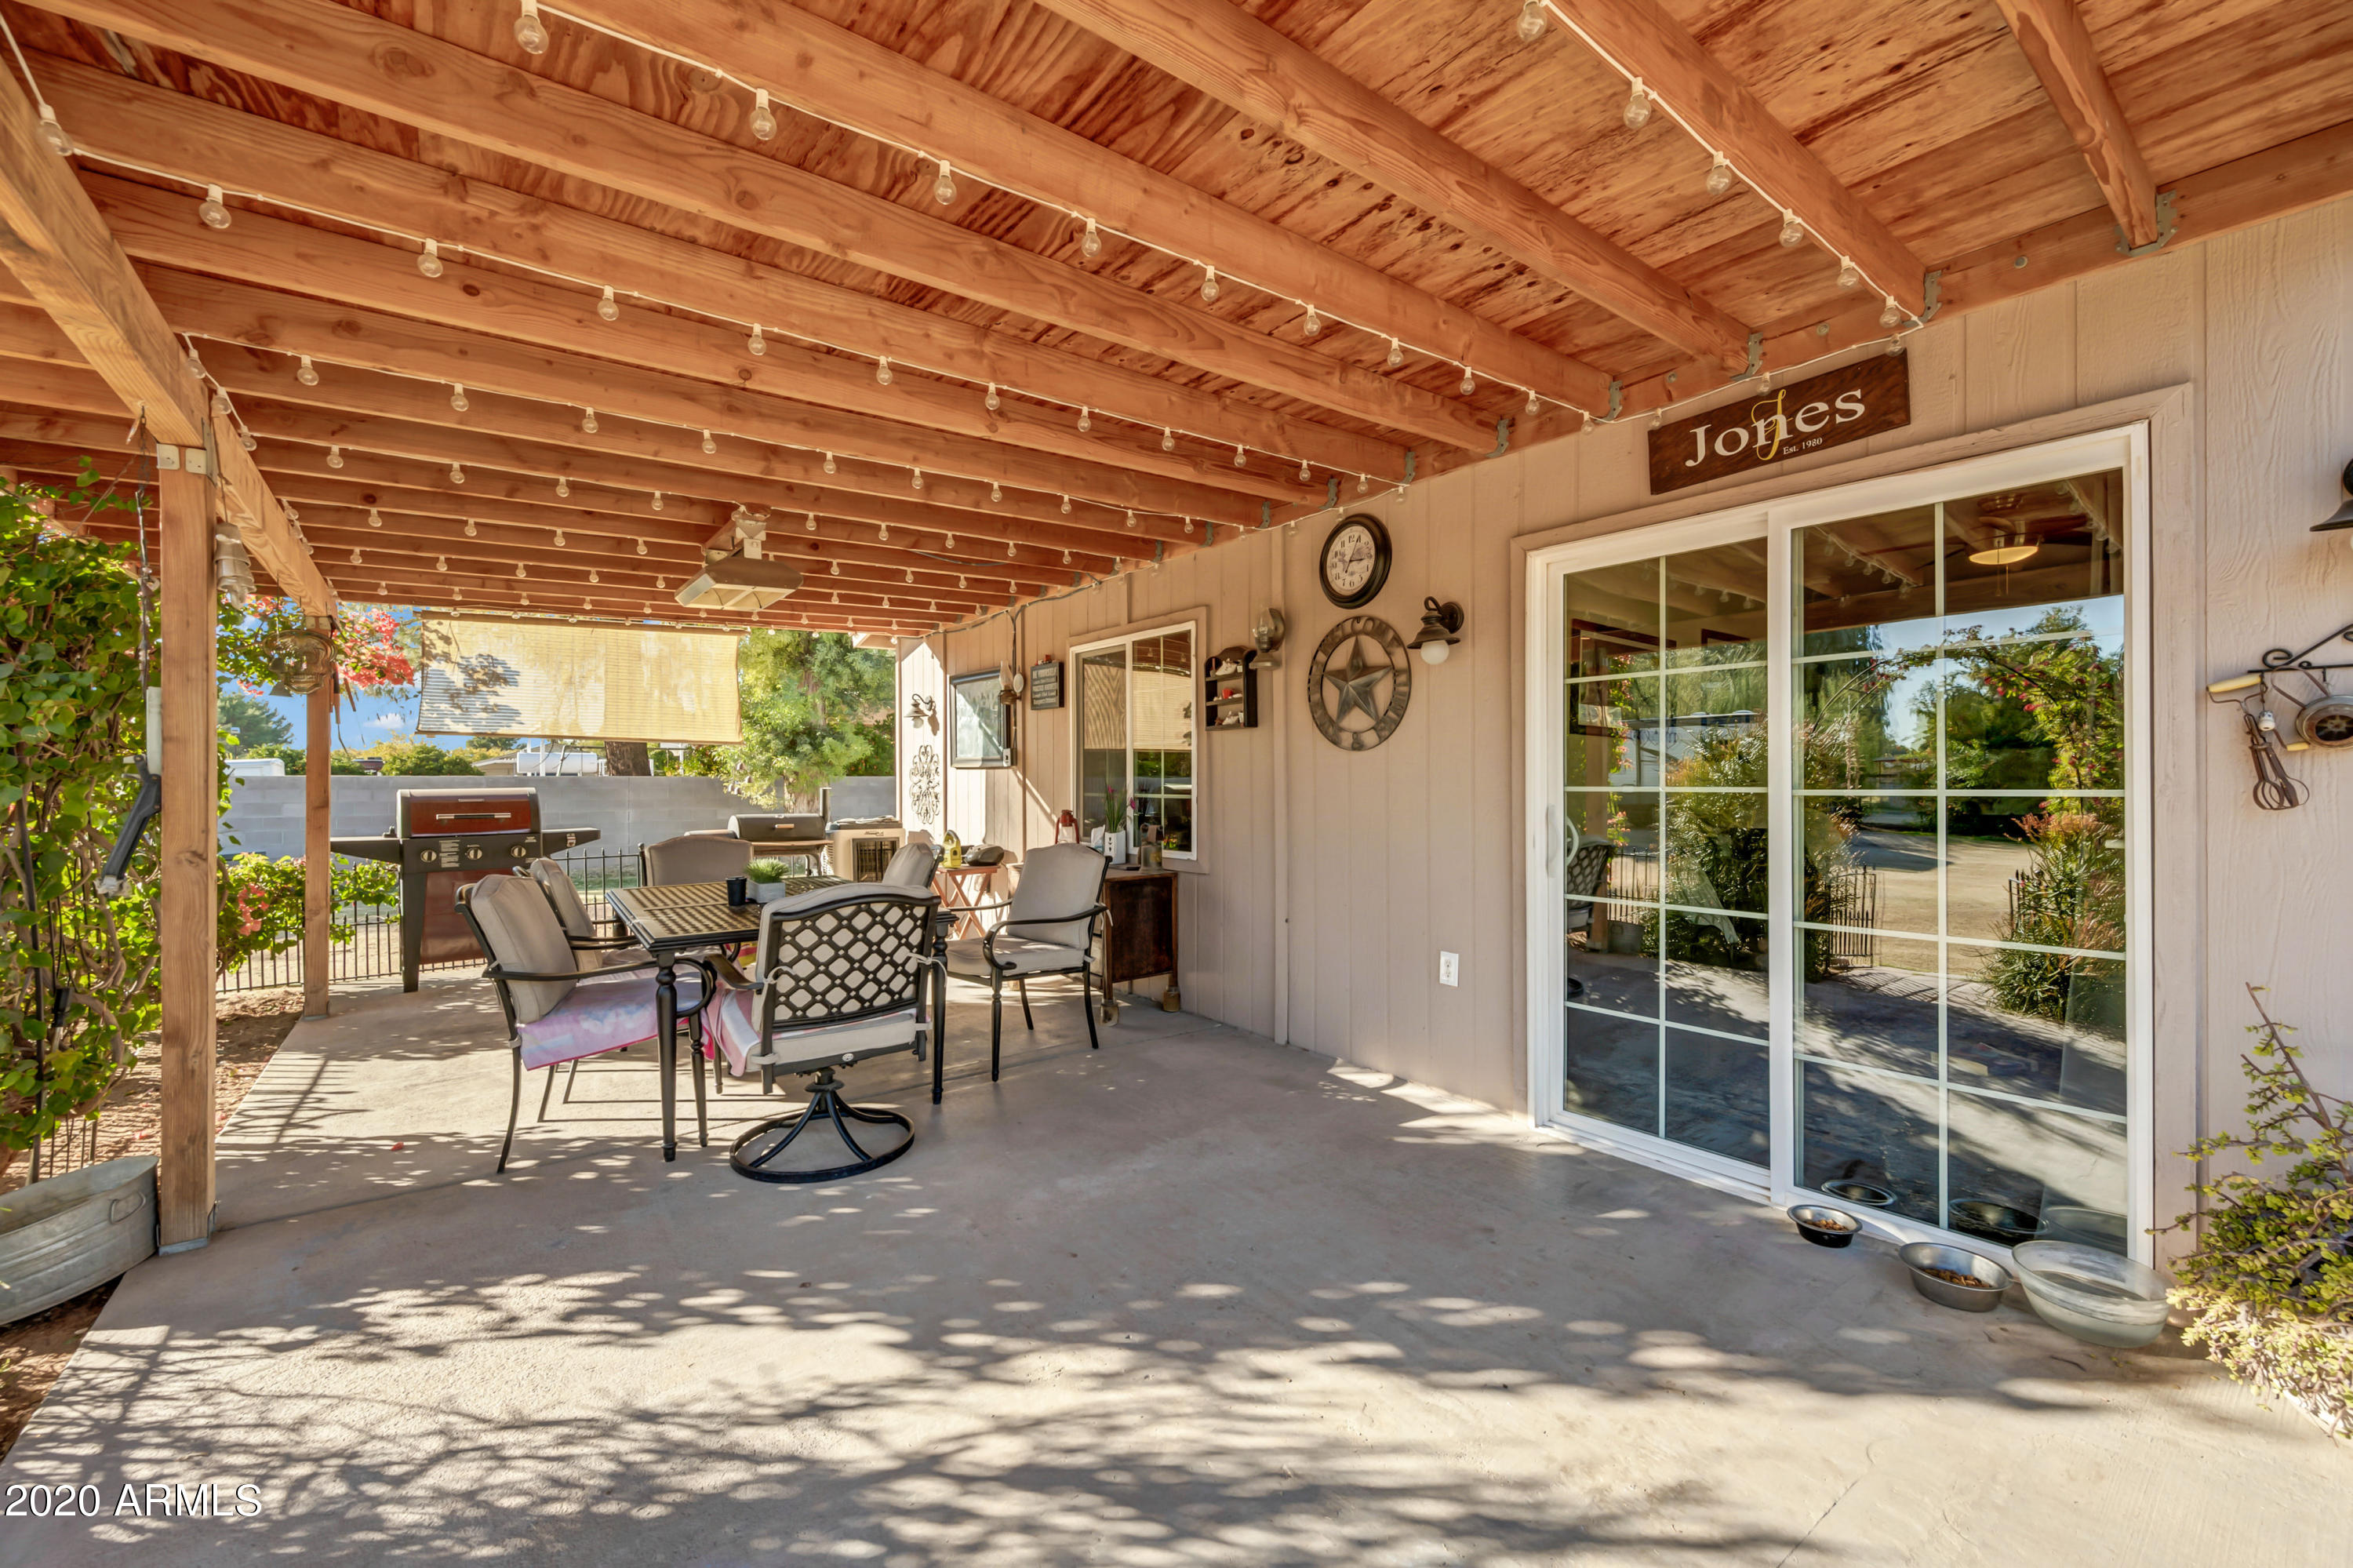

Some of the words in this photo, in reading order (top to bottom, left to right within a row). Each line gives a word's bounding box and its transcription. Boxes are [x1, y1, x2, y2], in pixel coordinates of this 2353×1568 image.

[1684, 388, 1866, 467] Jones
[1783, 446, 1799, 455] Est.
[1802, 437, 1823, 449] 1980
[1340, 540, 1345, 548] 11
[1348, 534, 1355, 544] 12
